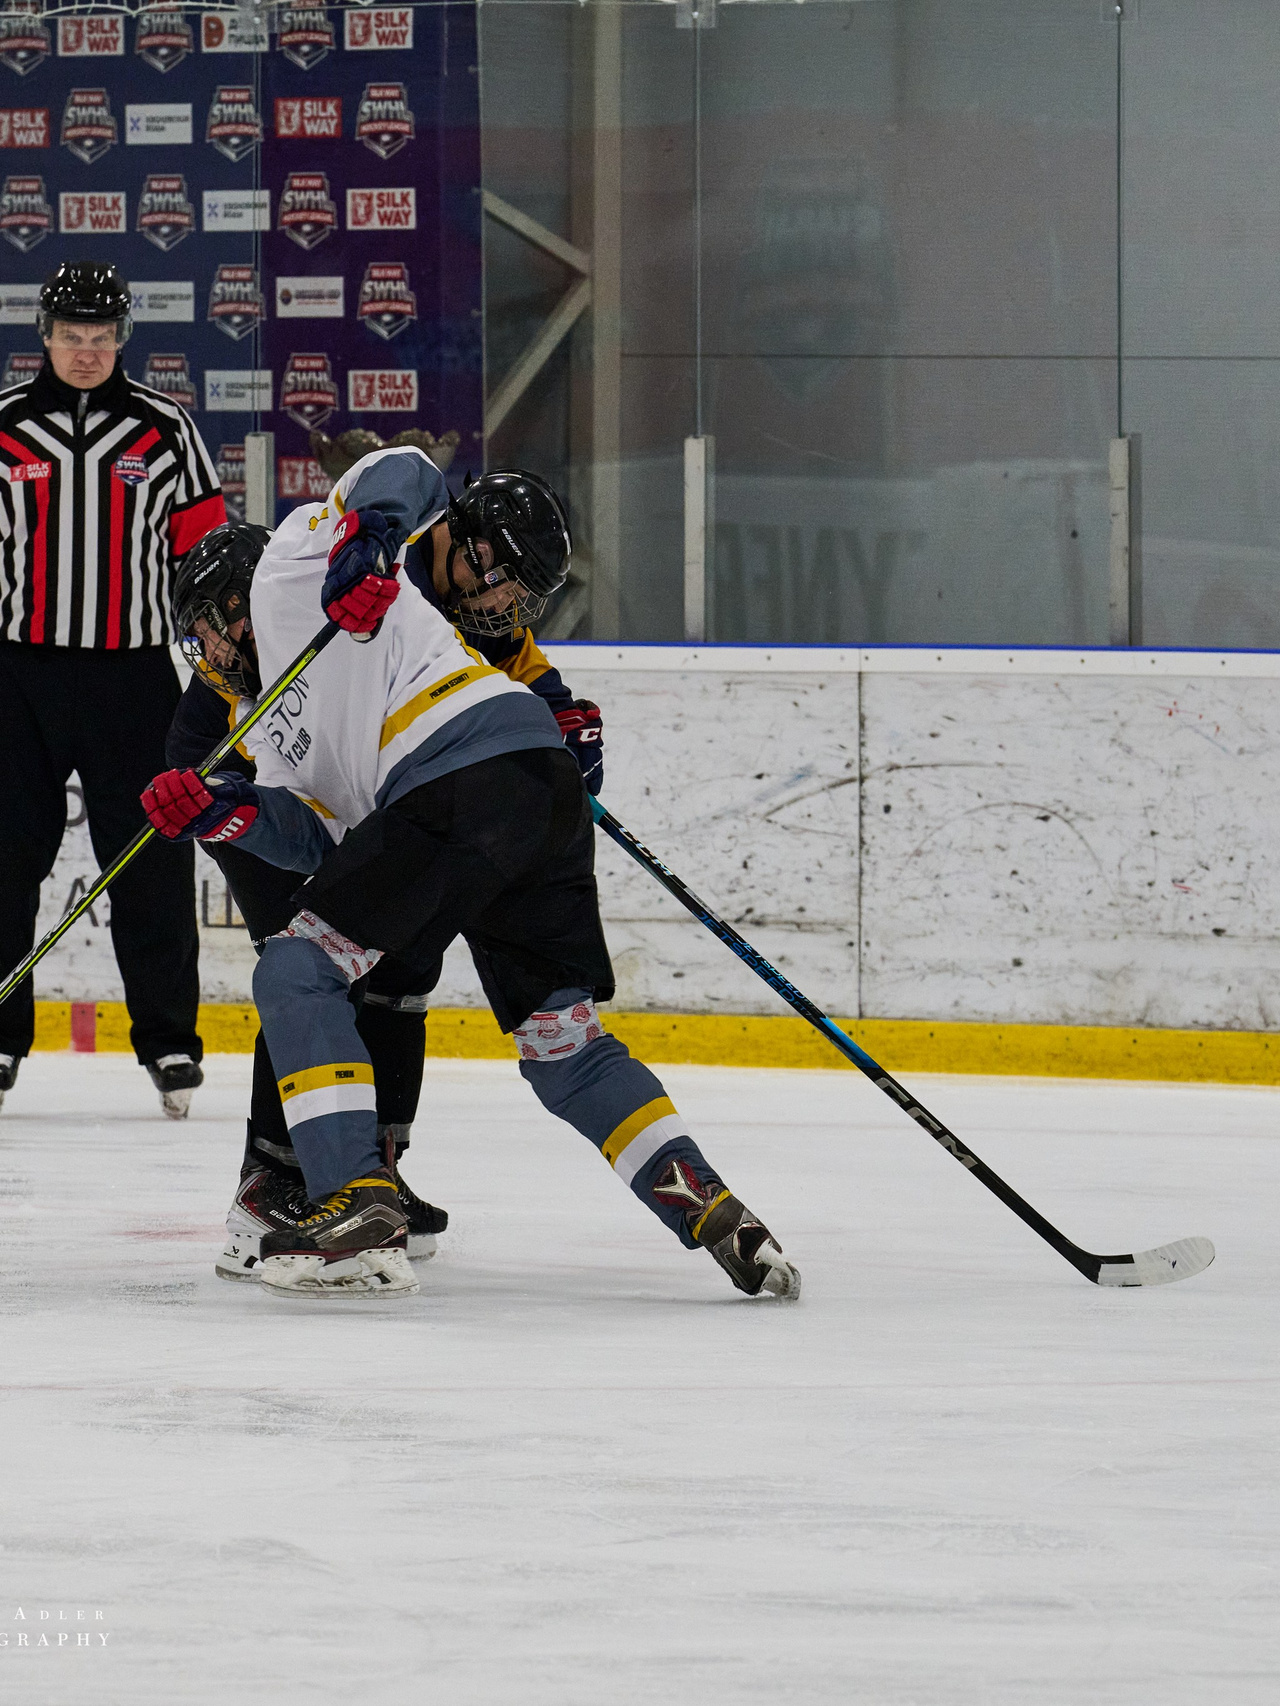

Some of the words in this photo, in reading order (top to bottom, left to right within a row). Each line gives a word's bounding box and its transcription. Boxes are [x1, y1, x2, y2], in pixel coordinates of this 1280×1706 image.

[87, 18, 119, 34] SILK
[374, 12, 409, 27] SILK
[87, 37, 119, 52] WAY
[375, 30, 409, 46] WAY
[303, 101, 338, 117] SILK
[13, 112, 46, 128] SILK
[305, 119, 337, 135] WAY
[13, 130, 45, 145] WAY
[89, 196, 121, 211] SILK
[376, 192, 412, 208] SILK
[90, 214, 121, 230] WAY
[377, 210, 412, 226] WAY
[379, 374, 413, 390] SILK
[379, 392, 414, 408] WAY
[27, 463, 49, 471] SILK
[27, 471, 49, 479] WAY
[501, 528, 523, 556] BAUER
[194, 560, 220, 585] BAUER
[292, 727, 312, 761] CLUB
[619, 827, 674, 877] CCM
[692, 909, 795, 1002] JETSPEED
[874, 1077, 978, 1169] CCM
[269, 1209, 297, 1226] BAUE
